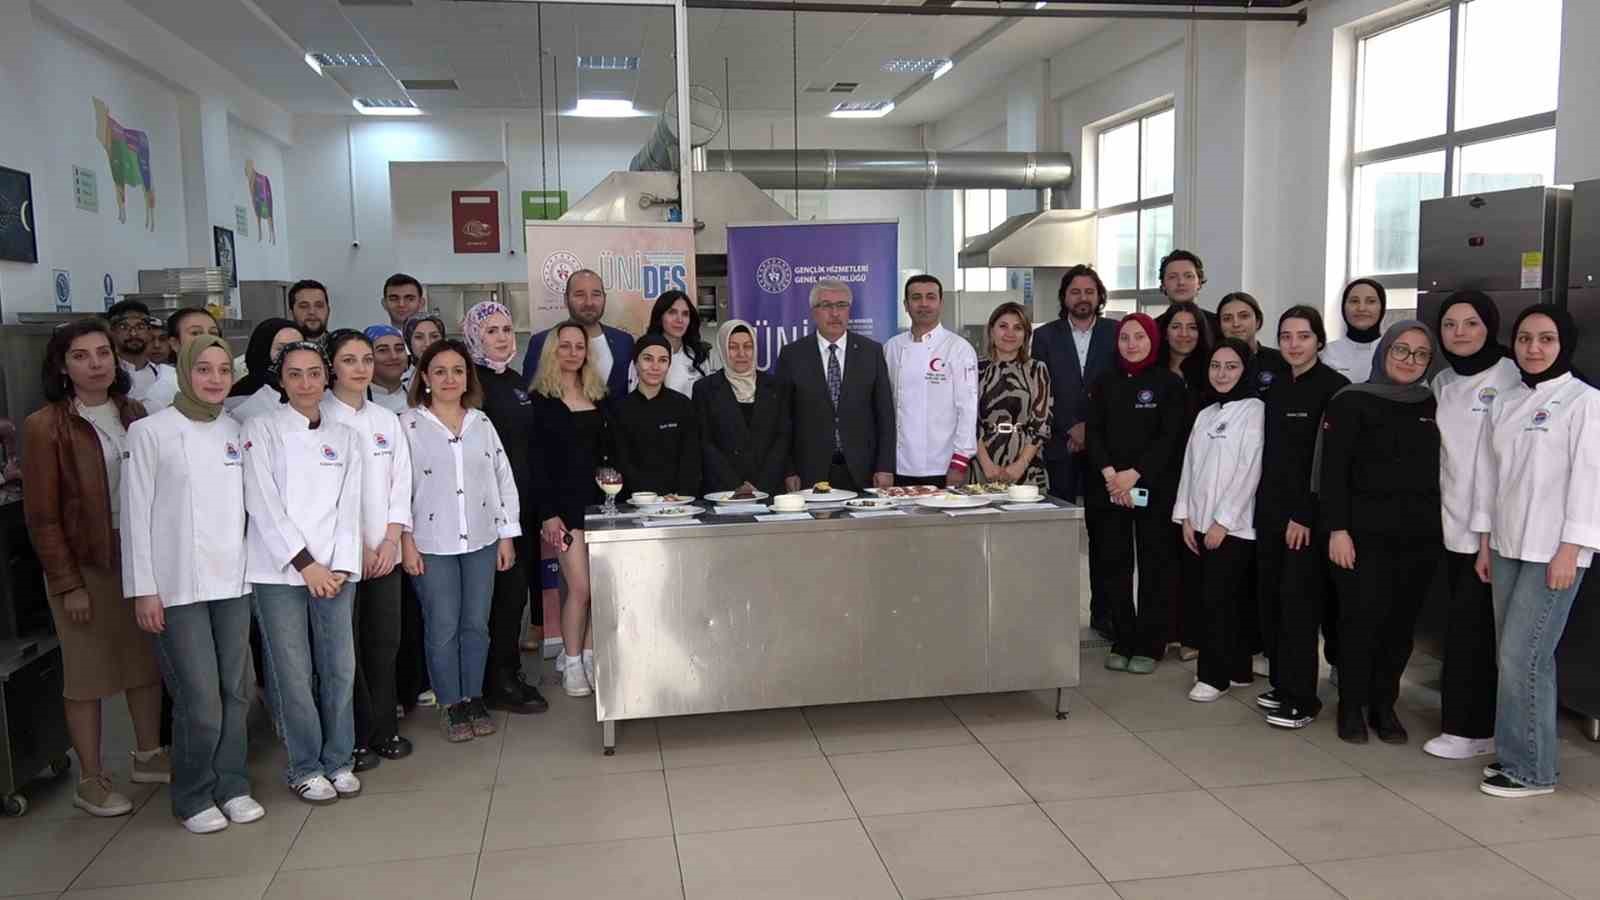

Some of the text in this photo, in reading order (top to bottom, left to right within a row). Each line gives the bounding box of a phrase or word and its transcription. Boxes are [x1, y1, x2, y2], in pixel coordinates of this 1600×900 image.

[599, 251, 640, 290] ÜNİ
[794, 264, 869, 275] GENÇLİK HİZMETLERİ
[794, 276, 817, 284] GENEL
